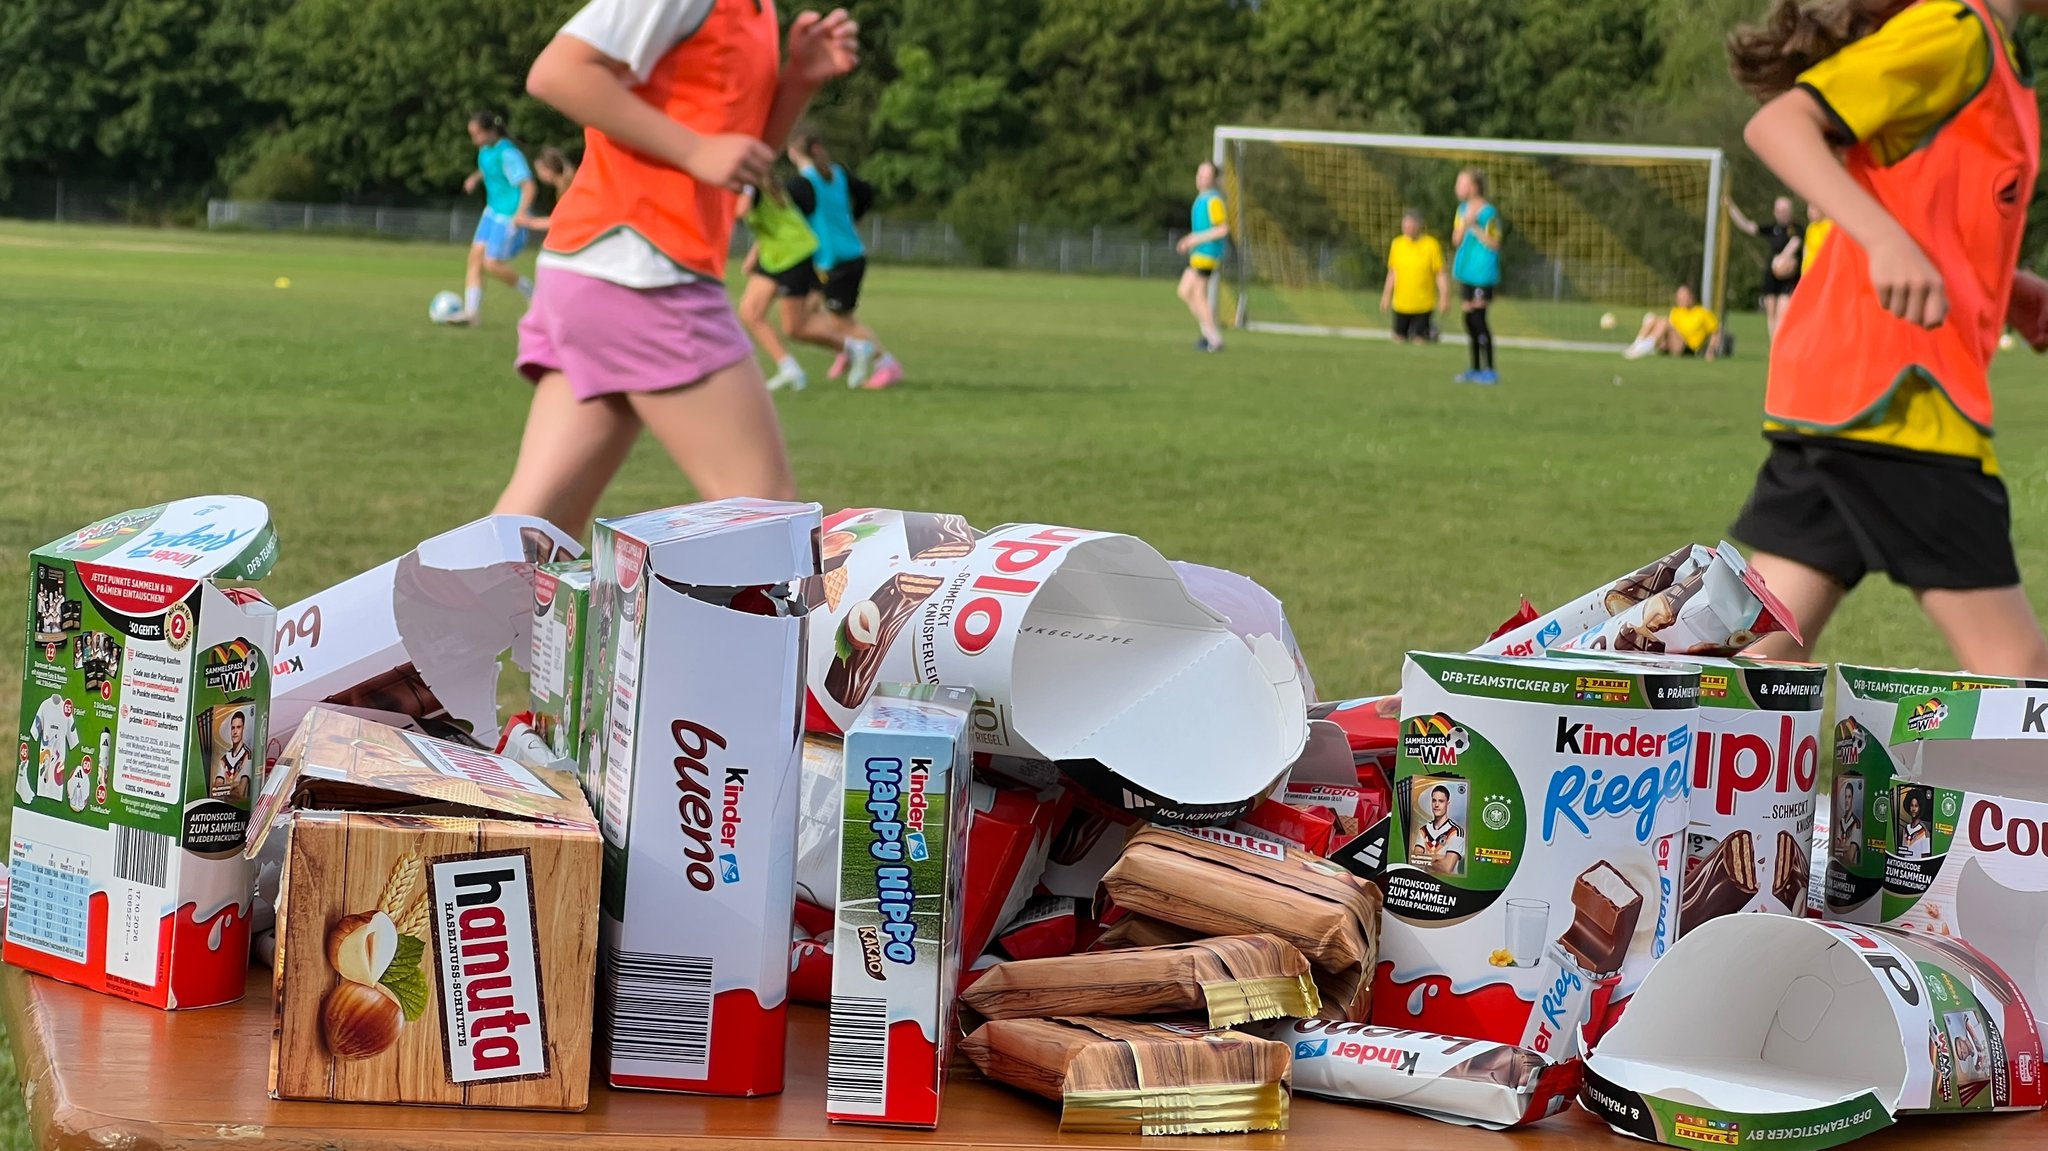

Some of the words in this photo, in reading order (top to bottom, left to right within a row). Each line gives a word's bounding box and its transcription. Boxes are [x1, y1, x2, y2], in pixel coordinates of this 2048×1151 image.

[91, 572, 107, 582] JETZT
[108, 575, 131, 586] PUNKTE
[132, 578, 159, 592] SAMMELN
[160, 583, 165, 592] &
[166, 584, 172, 593] IN
[954, 528, 1096, 653] uplo
[96, 583, 121, 596] PRÄMIEN
[123, 588, 165, 603] EINTAUSCHEN!
[175, 618, 182, 633] 2
[205, 660, 243, 675] SAMMELSPASS
[273, 656, 304, 675] Kin
[209, 674, 220, 684] ZUR
[221, 670, 251, 692] WM
[1441, 670, 1550, 693] DFB-TEAMSTICKER
[1552, 682, 1570, 693] BY
[1592, 679, 1628, 688] PANINI
[1760, 683, 1768, 694] &
[1771, 682, 1810, 695] PRÄMIEN
[1853, 679, 1930, 695] DFB-TEAMSTICKER
[1576, 692, 1629, 700] FAMILY
[1657, 687, 1664, 698] &
[1667, 686, 1694, 698] PRÄMIEN
[2022, 696, 2048, 732] K
[1918, 717, 1939, 731] WM
[975, 731, 1003, 745] RIEGEL
[1404, 736, 1445, 745] SAMMELSPASS
[1555, 716, 1667, 757] Kinder
[1420, 746, 1458, 764] WM
[1693, 715, 1817, 815] plo
[907, 757, 932, 832] Kinder
[1312, 786, 1359, 797] duplo
[1542, 732, 1692, 842] Riegel
[671, 719, 727, 891] bueno
[720, 767, 749, 848] Kinder
[866, 758, 903, 861] Happy
[1157, 808, 1185, 820] VON
[190, 812, 237, 822] AKTIONSCODE
[1186, 810, 1238, 821] PRÄMIEN
[190, 823, 209, 834] ZUM
[210, 820, 246, 833] SAMMELN
[188, 835, 194, 843] IN
[195, 835, 214, 843] JEDER
[1886, 858, 1921, 872] AKTIONSCODE
[1389, 876, 1441, 892] AKTIONSCODE
[1886, 866, 1899, 877] ZUM
[1900, 869, 1932, 884] SAMMELN
[1388, 885, 1408, 898] ZUM
[1409, 890, 1457, 907] SAMMELN
[1393, 899, 1413, 908] JEDER
[859, 927, 883, 973] KAKAO
[445, 902, 467, 1047] HASELNUSS-SCHNITTE
[454, 869, 530, 1071] hanuta
[1332, 1041, 1420, 1076] Kinder
[1588, 1085, 1627, 1115] PRÄMIEN
[1631, 1107, 1640, 1119] &
[1767, 1109, 1872, 1140] DFB-TEAMSTICKER
[1746, 1129, 1764, 1140] BY
